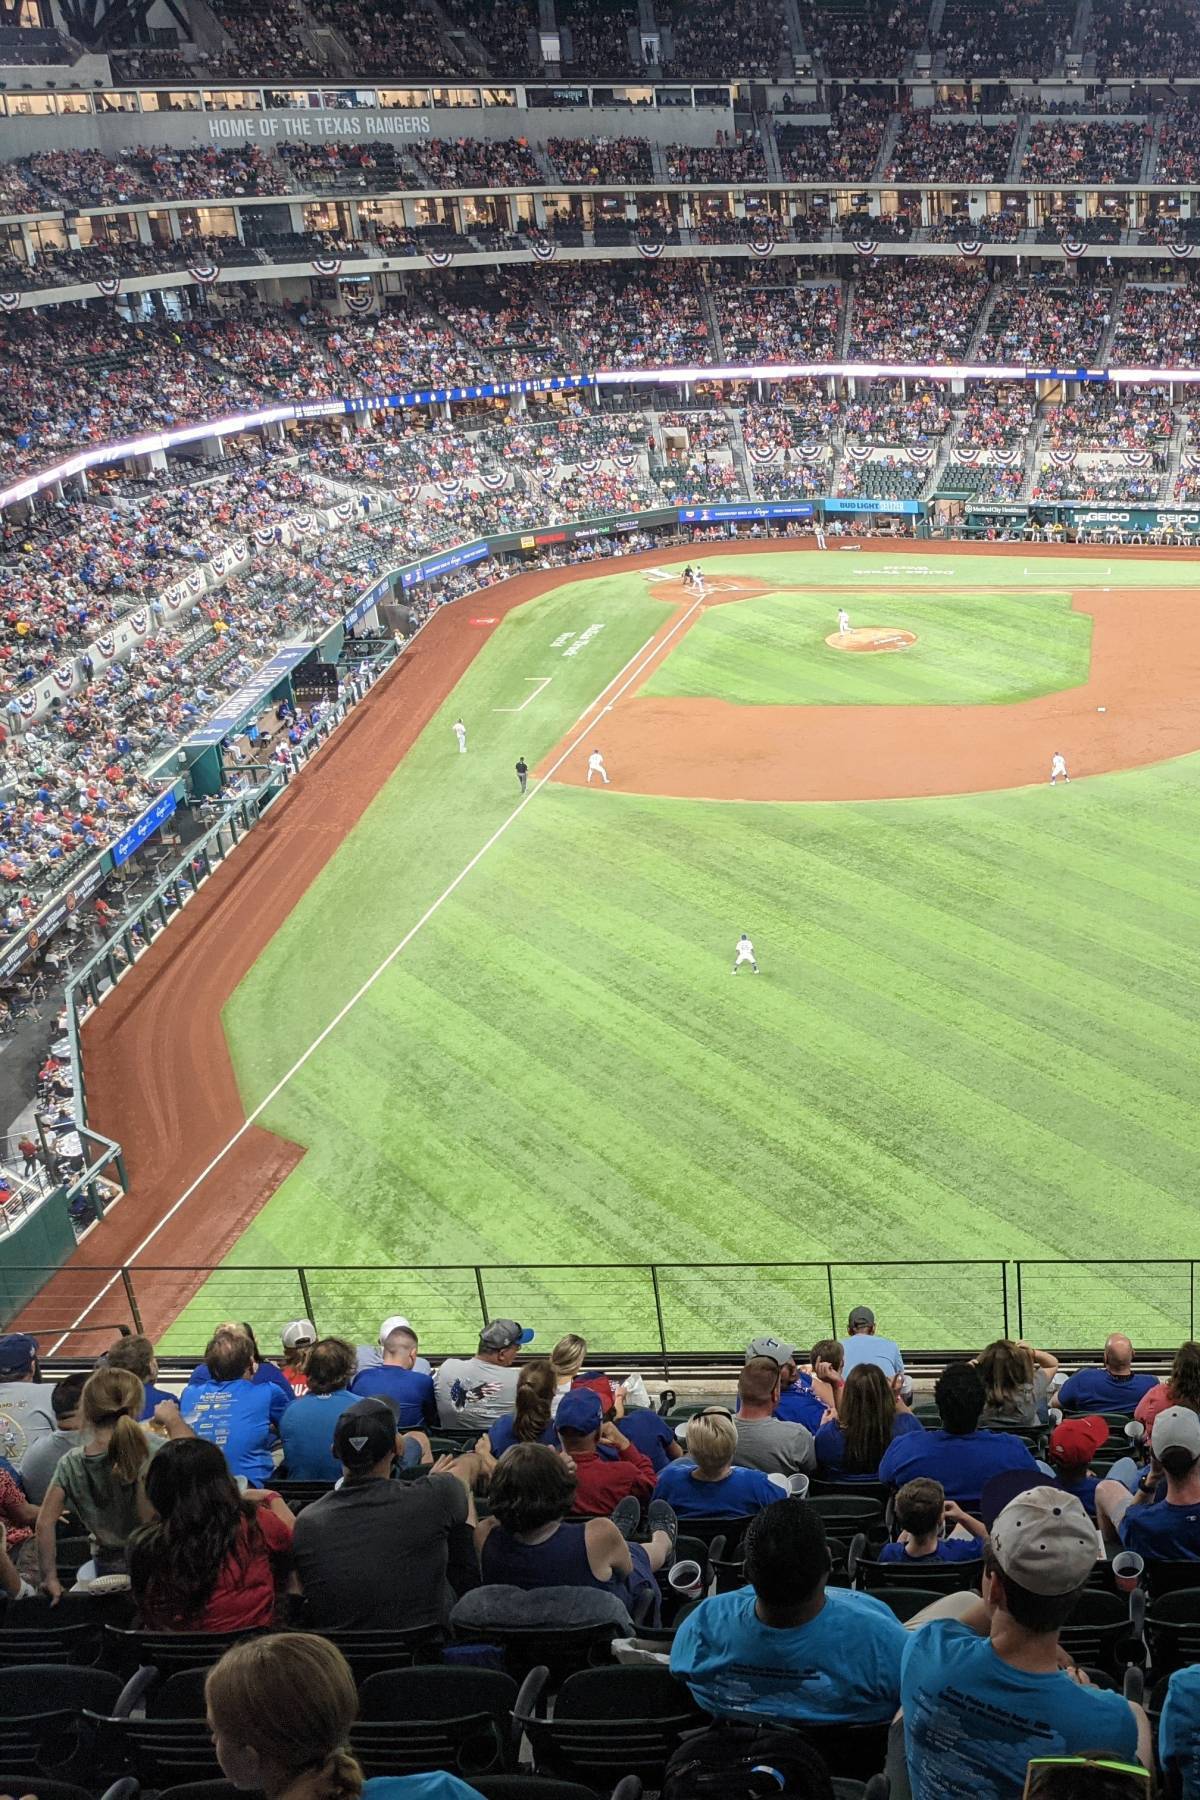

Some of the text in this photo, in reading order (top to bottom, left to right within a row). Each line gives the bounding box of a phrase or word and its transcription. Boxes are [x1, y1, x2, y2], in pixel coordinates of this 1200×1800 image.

[208, 116, 431, 138] HOME OF THE TEXAS RANGERS
[992, 506, 1001, 514] City
[1088, 512, 1129, 522] GEICO
[1157, 514, 1198, 524] GEICO
[575, 530, 589, 538] Globe
[590, 528, 598, 536] Life
